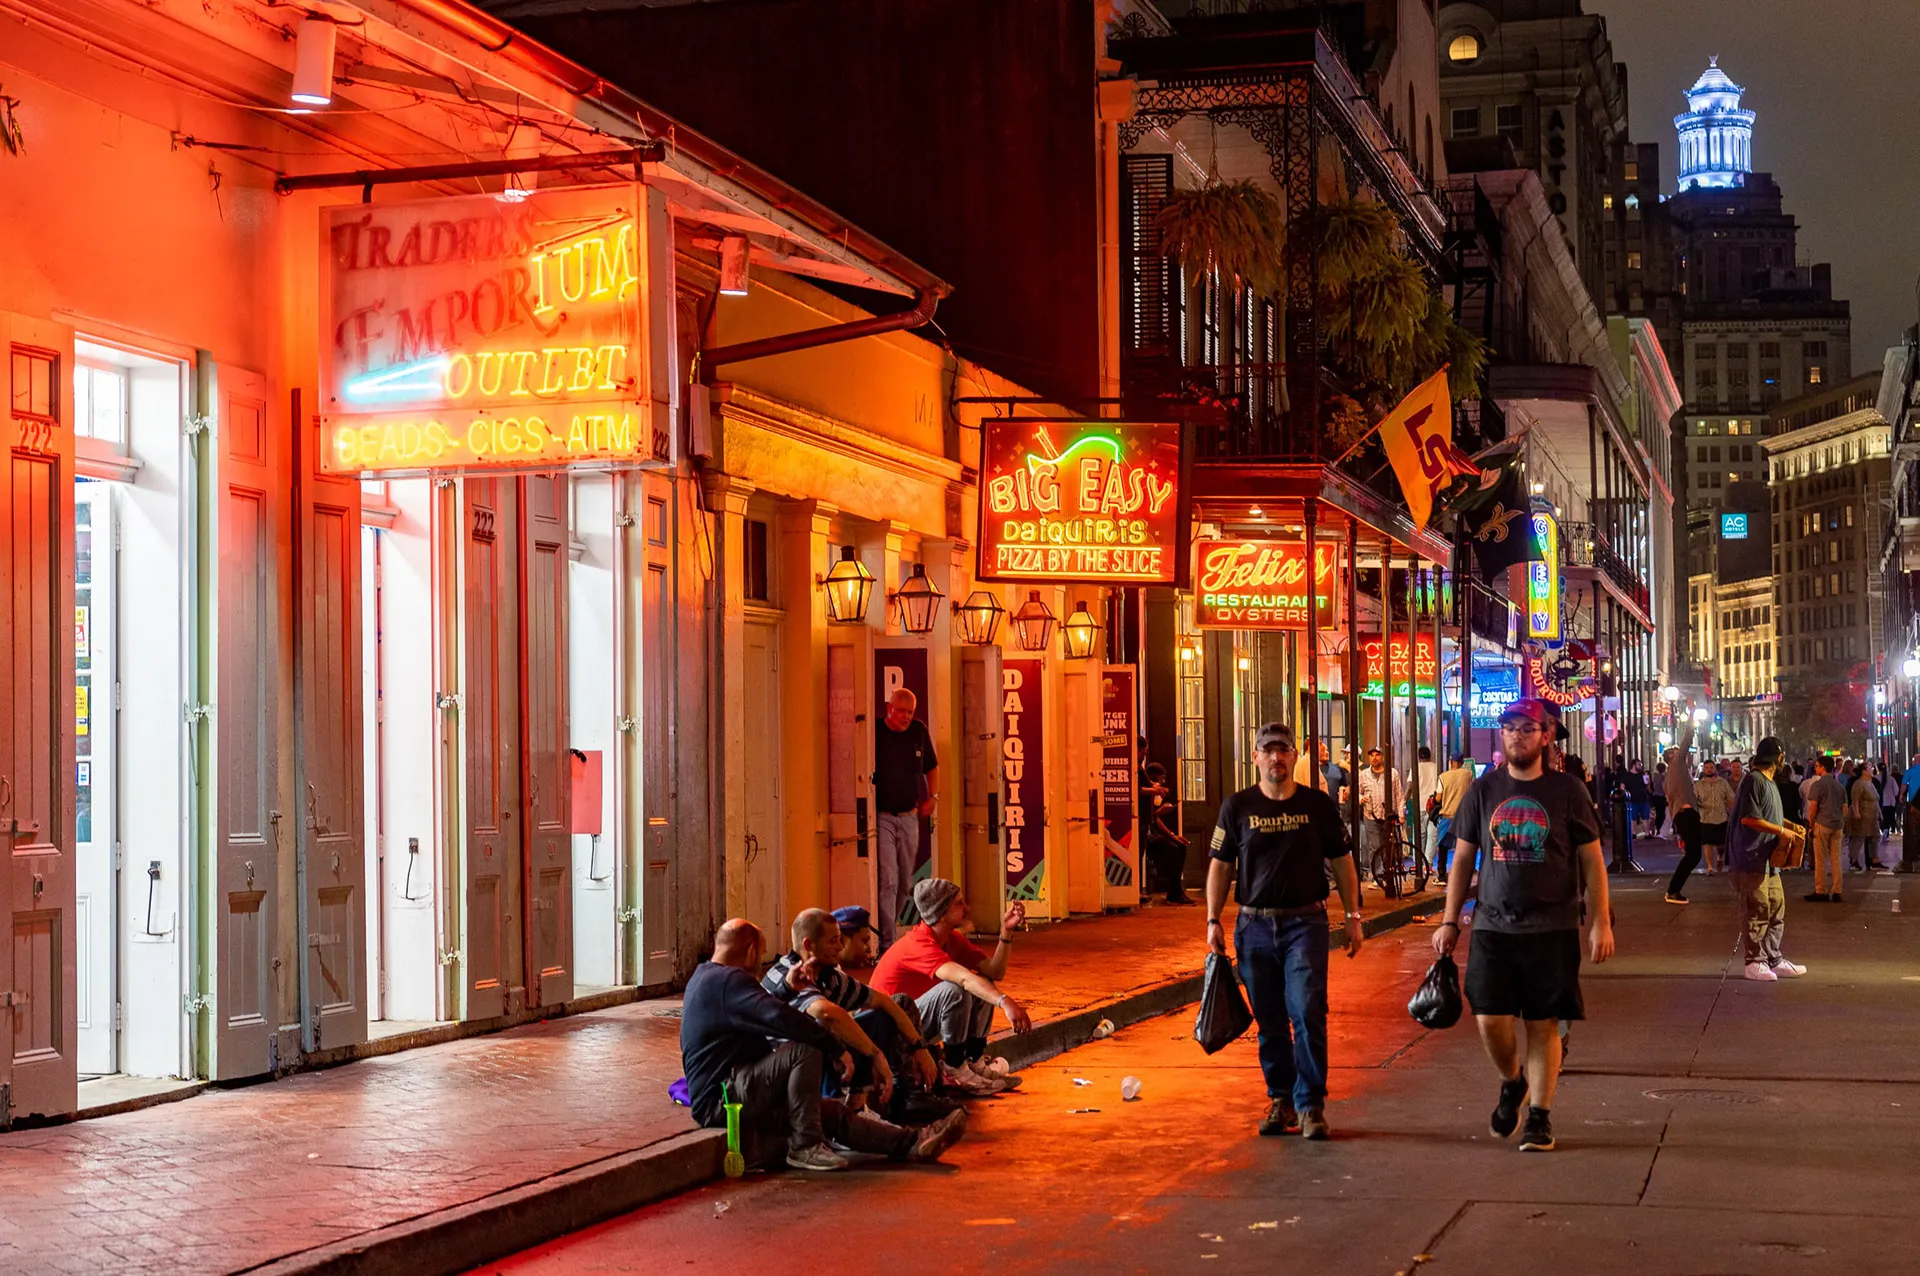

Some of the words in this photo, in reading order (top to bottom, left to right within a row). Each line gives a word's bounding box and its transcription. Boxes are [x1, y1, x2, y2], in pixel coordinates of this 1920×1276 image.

[1548, 108, 1567, 234] ASTO
[334, 223, 638, 374] EMPORIUM
[445, 345, 627, 398] OUTLET
[20, 419, 51, 455] 222
[989, 463, 1059, 514] BIG
[1079, 458, 1172, 514] EASY
[474, 510, 494, 536] 222
[1725, 516, 1744, 527] AC
[997, 548, 1042, 571] PIZZA
[1047, 548, 1071, 571] BY
[1075, 549, 1108, 572] THE
[1111, 549, 1162, 574] SLICE
[1530, 658, 1575, 705] BOURBON
[1003, 669, 1024, 872] DAIQUIRIS
[1248, 812, 1309, 829] Bourbon
